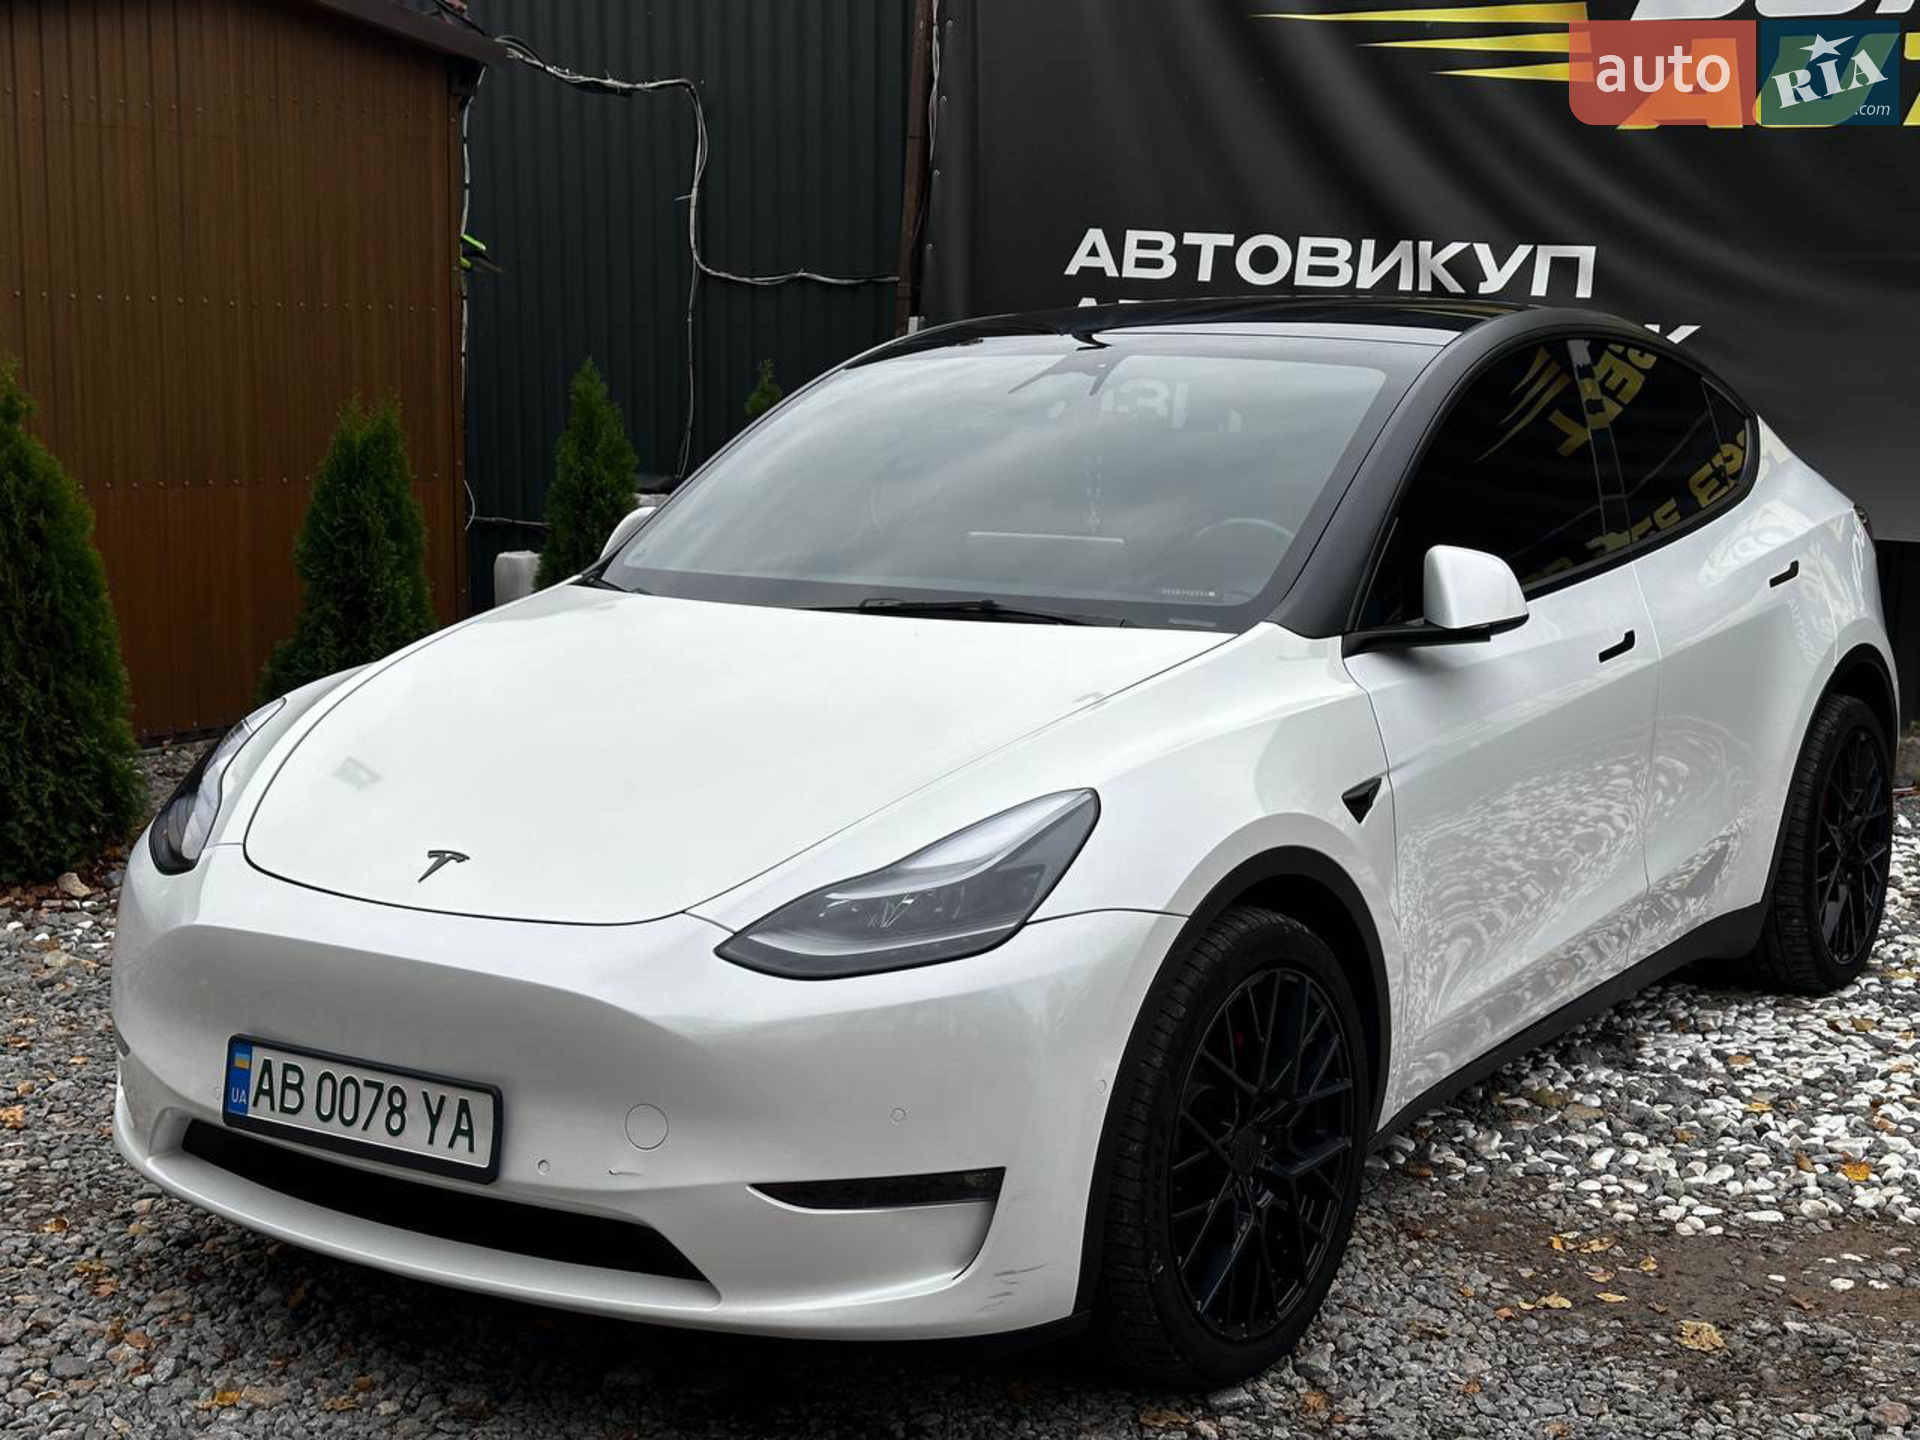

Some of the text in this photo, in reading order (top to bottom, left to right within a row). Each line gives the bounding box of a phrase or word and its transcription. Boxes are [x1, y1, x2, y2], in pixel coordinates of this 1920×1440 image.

[1064, 228, 1597, 298] АВТОВИКУП
[230, 1087, 247, 1105] UA
[251, 1058, 475, 1153] AB 0078 YA
